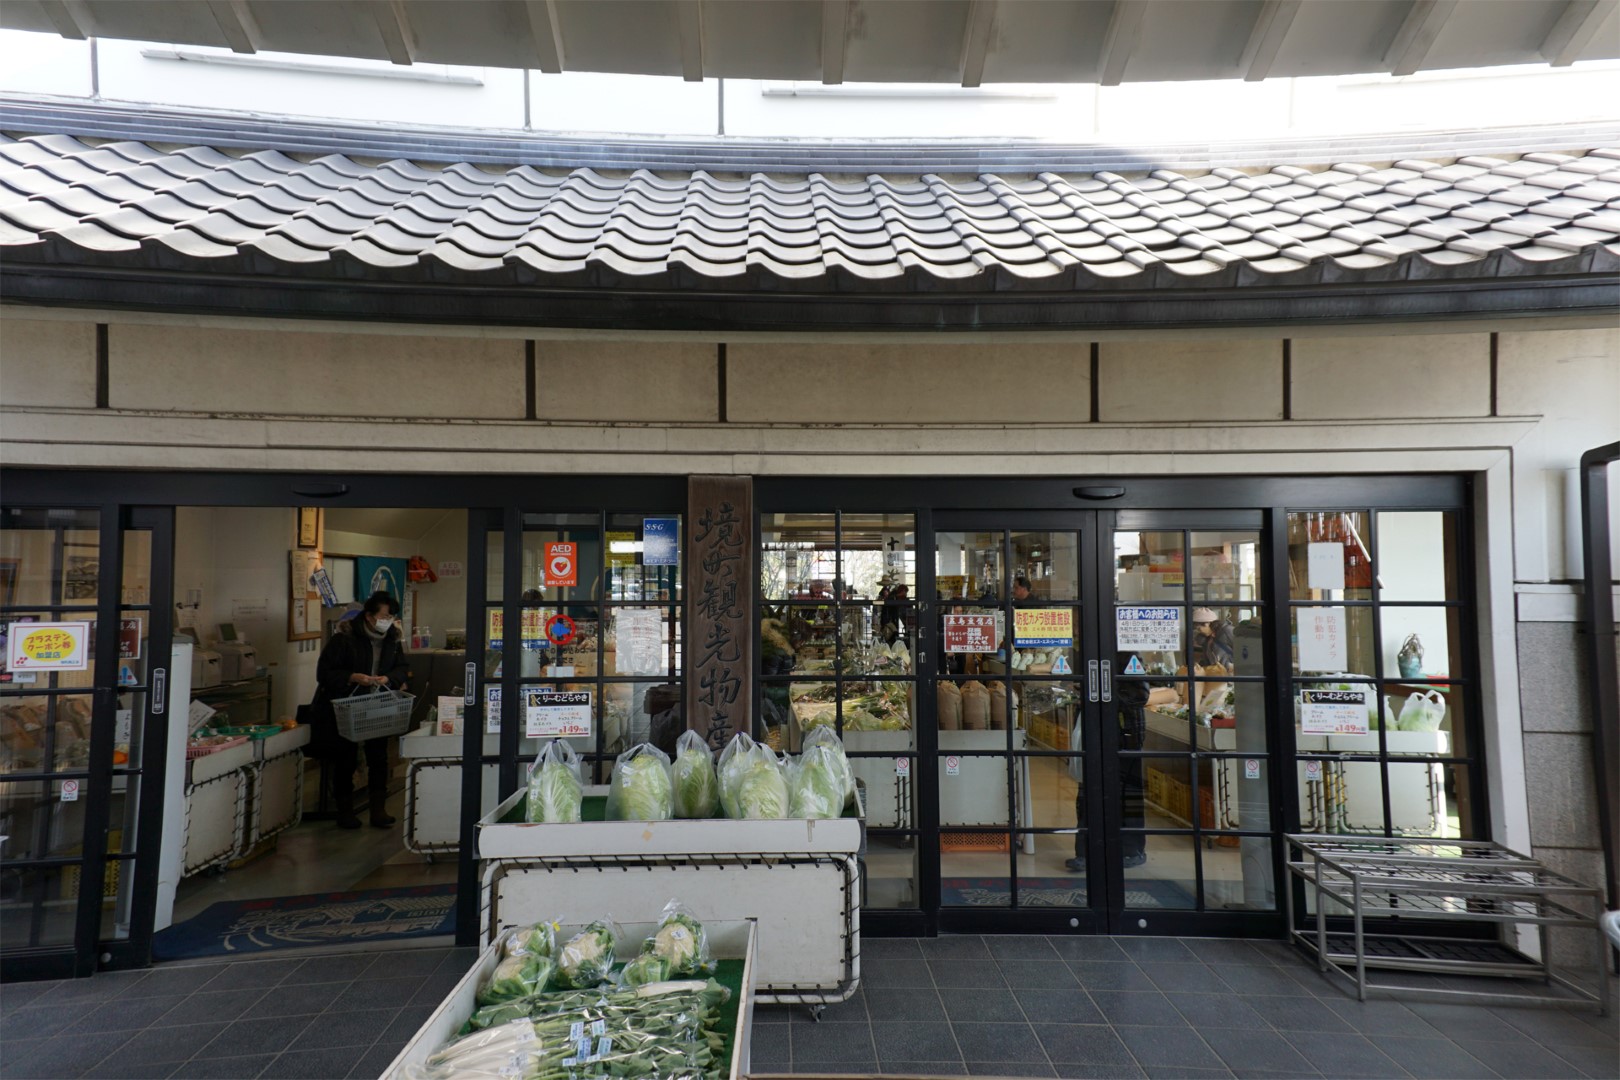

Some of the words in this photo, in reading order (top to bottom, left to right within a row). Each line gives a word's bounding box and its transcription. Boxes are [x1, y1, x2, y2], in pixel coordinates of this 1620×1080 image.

[551, 544, 572, 553] AED
[1015, 611, 1071, 626] 防犯カメラ設置施設
[1119, 609, 1177, 619] お客様へのお知らせ
[1314, 615, 1325, 641] 作動中
[694, 502, 744, 770] 境町観光物産
[1327, 615, 1337, 659] 防犯カメラ
[36, 651, 61, 659] 加盟店
